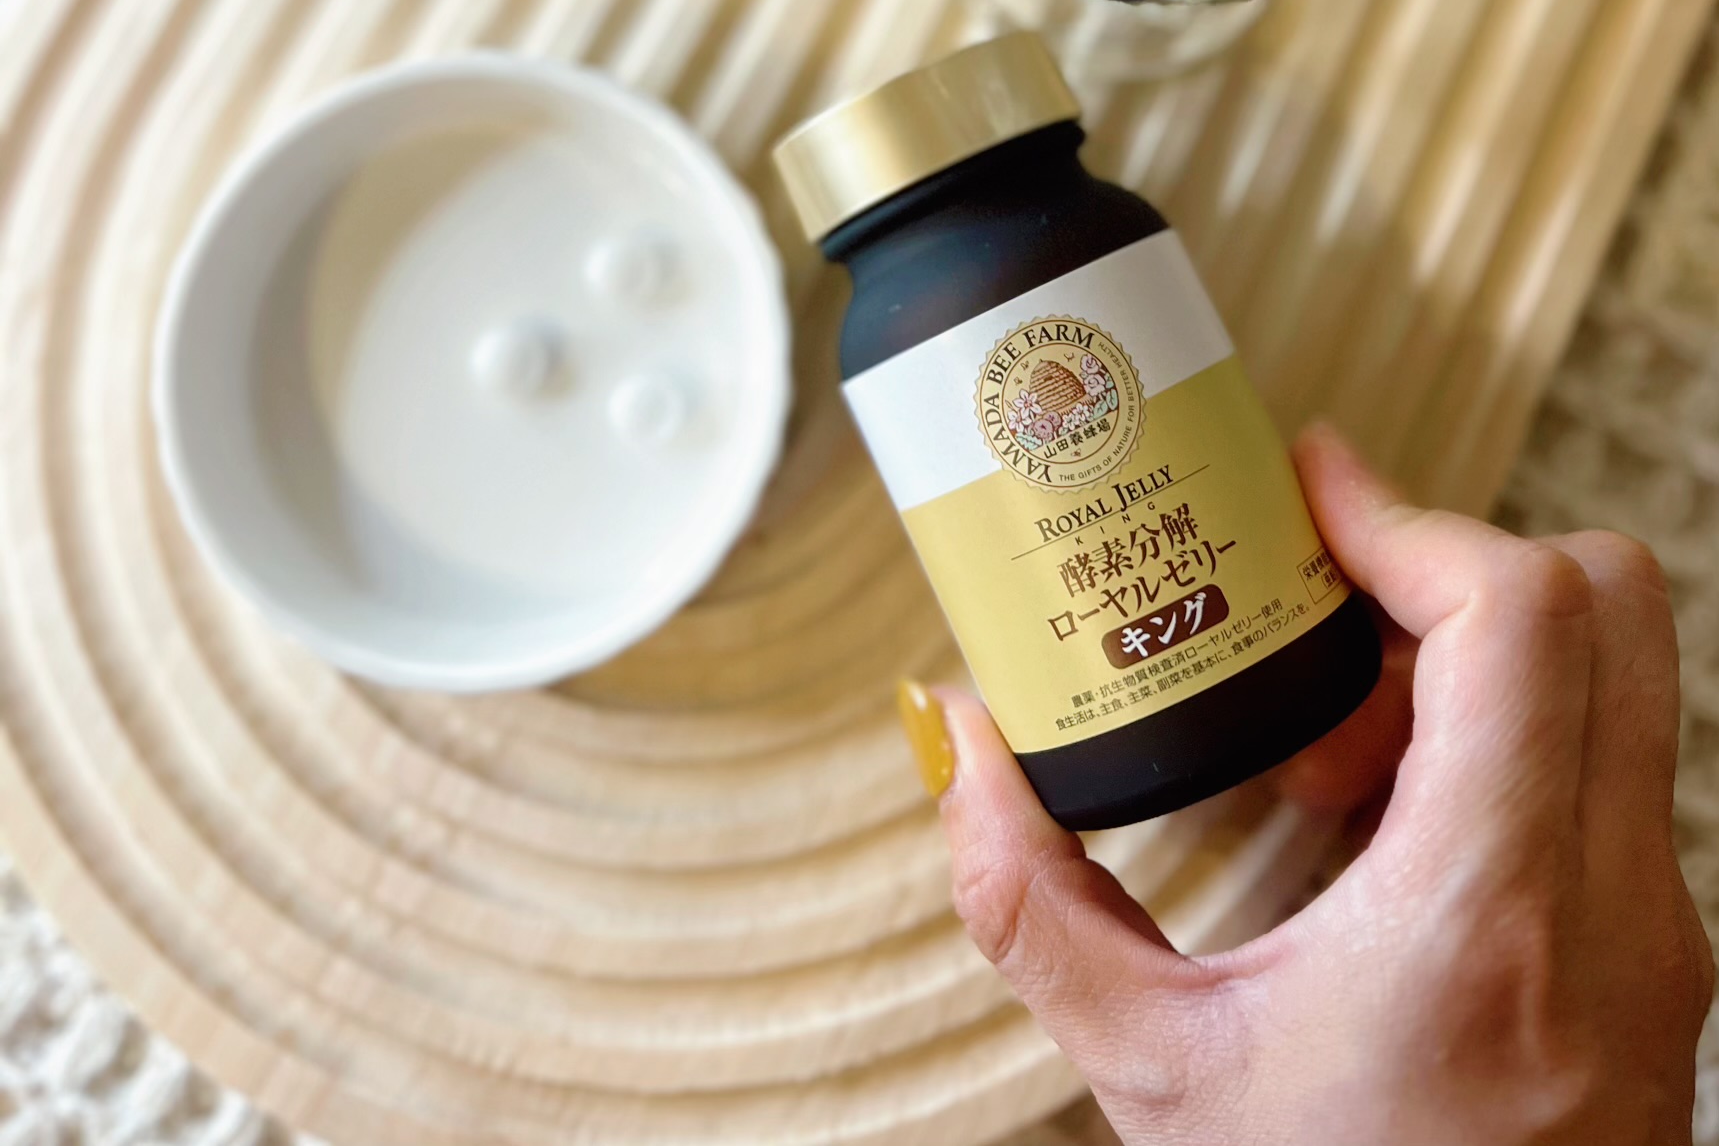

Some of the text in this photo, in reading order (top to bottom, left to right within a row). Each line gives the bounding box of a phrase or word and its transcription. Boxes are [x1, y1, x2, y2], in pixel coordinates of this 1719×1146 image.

[1098, 341, 1122, 368] HEALTH
[1120, 369, 1135, 402] BETTER
[984, 324, 1095, 483] YAMADA BEE FARM
[1113, 425, 1132, 457] NATURE
[1059, 473, 1076, 482] THE
[1078, 464, 1102, 479] GIFTS
[1103, 456, 1113, 466] OF
[1034, 465, 1174, 542] ROYAL JELLY
[1056, 503, 1199, 598] 酵素分解
[1048, 540, 1237, 641] ローヤルゼリー
[1120, 592, 1206, 658] キング
